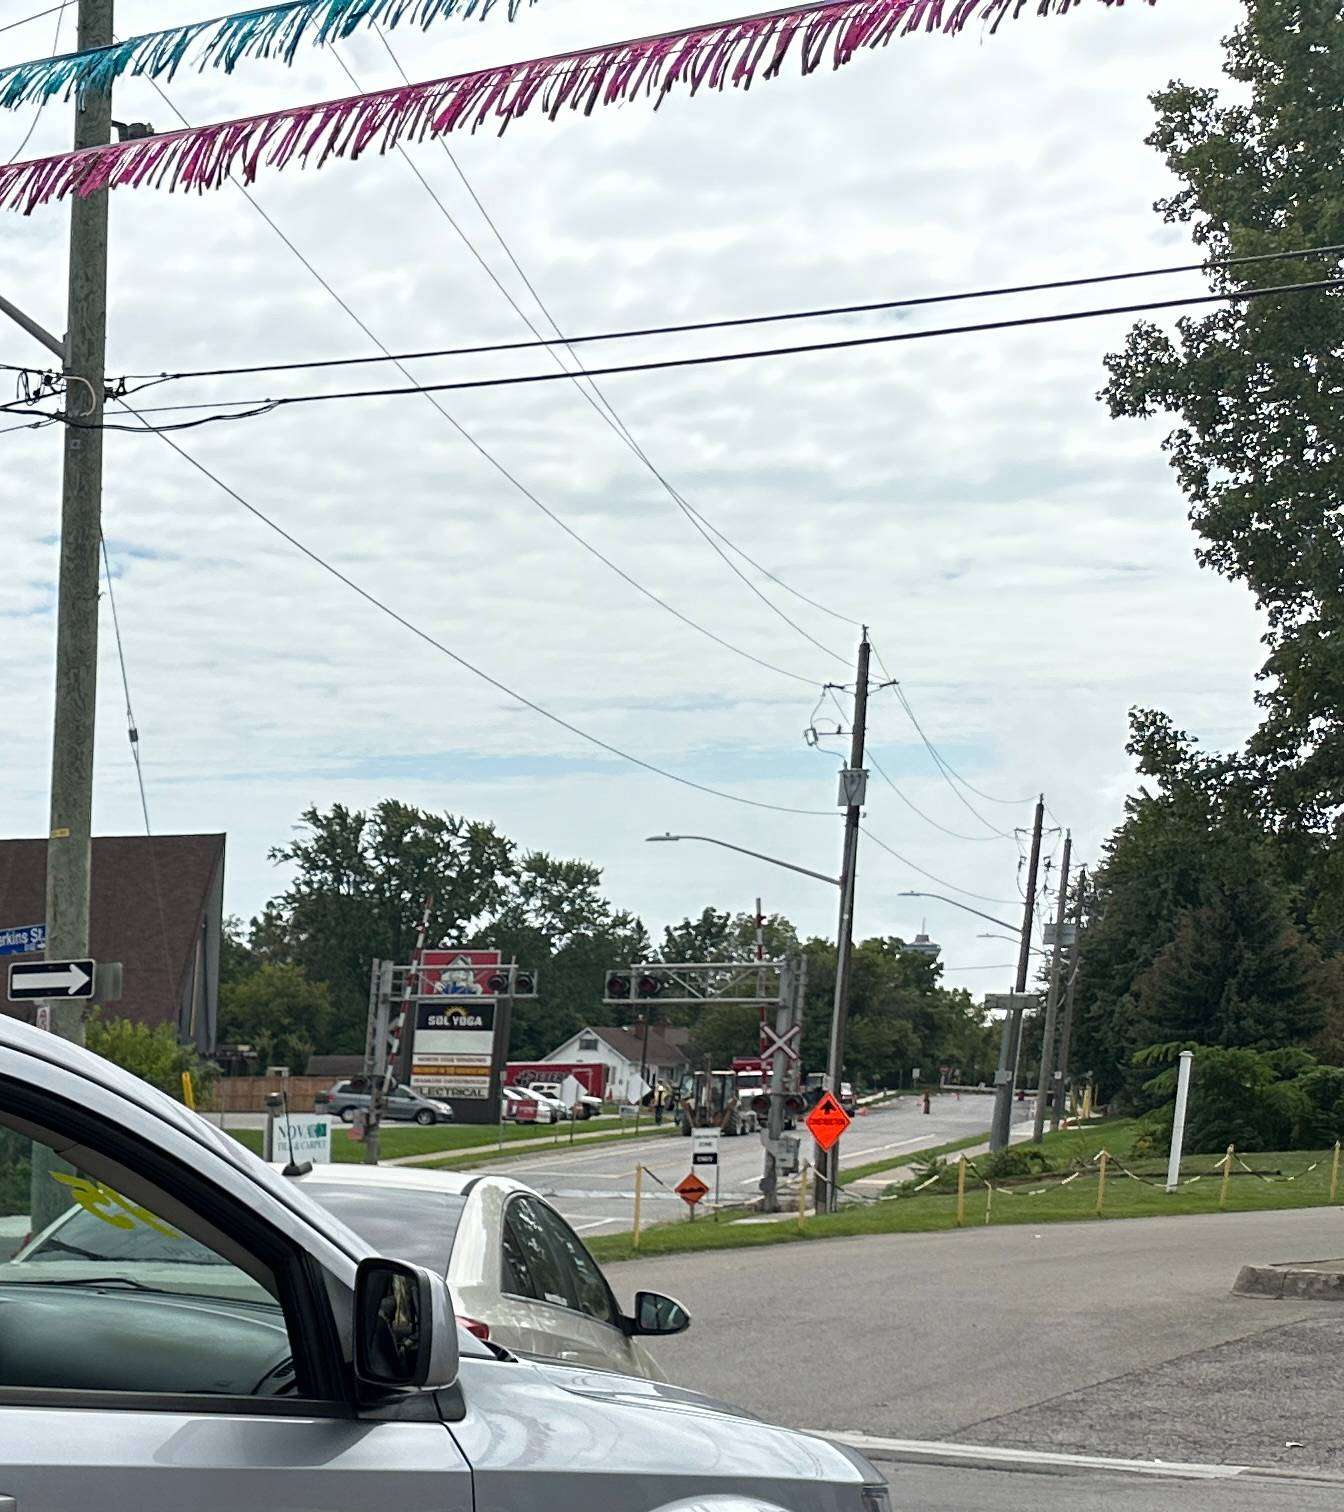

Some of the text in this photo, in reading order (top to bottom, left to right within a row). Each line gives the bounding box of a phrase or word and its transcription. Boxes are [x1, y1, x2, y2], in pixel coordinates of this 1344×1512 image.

[428, 1015, 483, 1027] SOL YOGA
[417, 1087, 485, 1097] LECTRICAL
